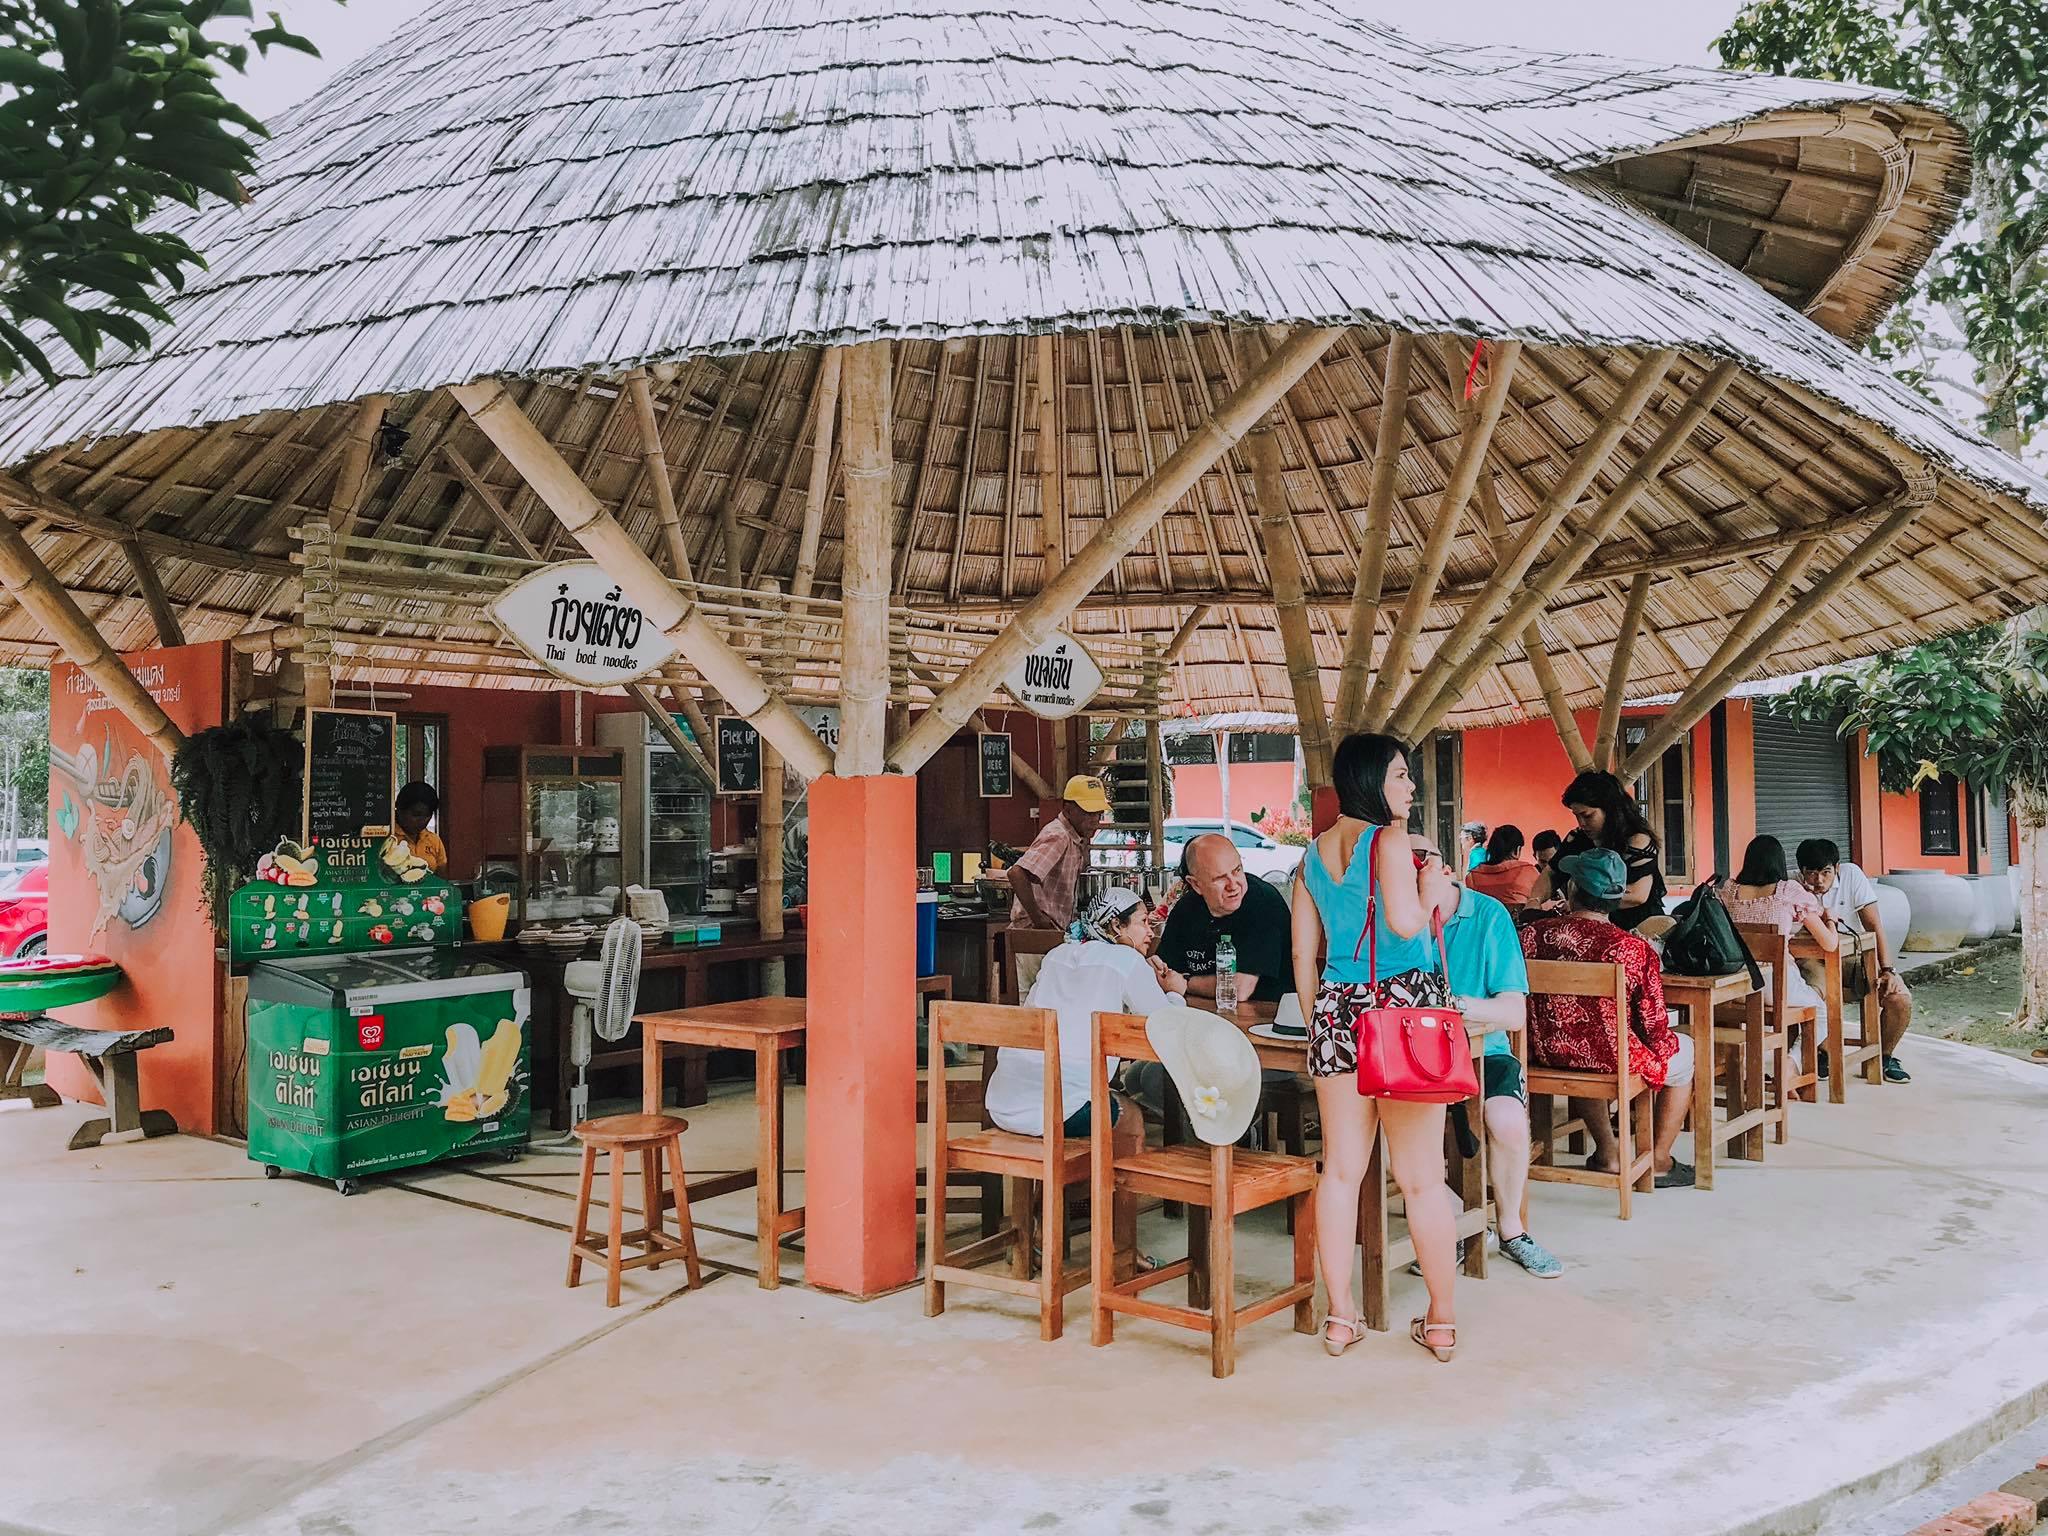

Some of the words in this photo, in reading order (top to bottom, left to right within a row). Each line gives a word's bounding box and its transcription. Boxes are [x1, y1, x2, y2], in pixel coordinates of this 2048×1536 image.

[546, 644, 566, 661] Thai
[576, 648, 597, 665] boat
[603, 655, 638, 670] noodles
[745, 731, 757, 745] UP
[347, 1115, 380, 1131] ASIAN
[381, 1109, 425, 1124] DELIGHT
